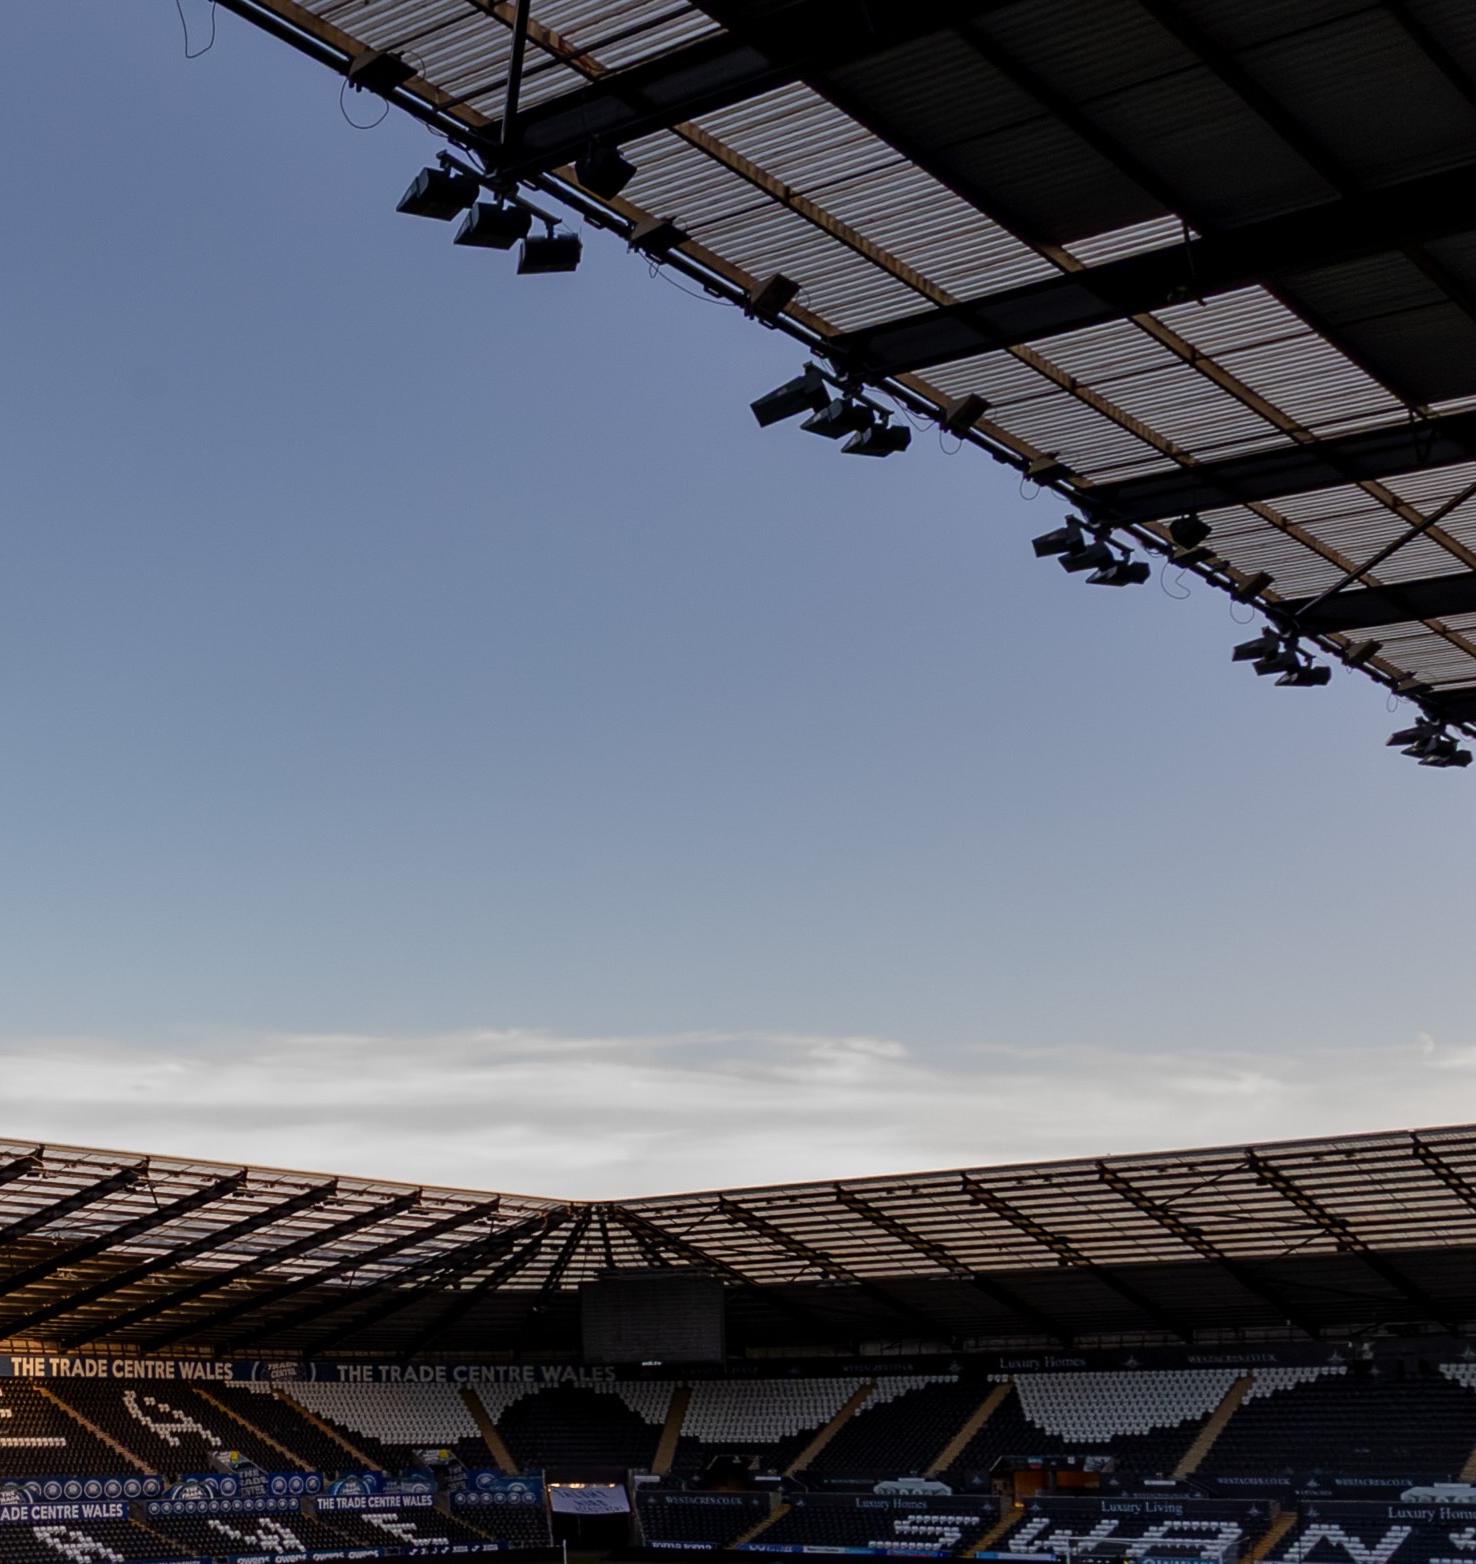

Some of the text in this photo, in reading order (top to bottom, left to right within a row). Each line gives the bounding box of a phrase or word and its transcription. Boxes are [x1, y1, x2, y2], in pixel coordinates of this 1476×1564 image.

[11, 1356, 234, 1381] THE TRADE CENTRE WALES
[1000, 1355, 1086, 1371] Luxury Homes
[336, 1365, 616, 1383] THE TRADE CENTRE WALES
[317, 1494, 433, 1510] THE TRADE CENTRE WALES
[855, 1497, 928, 1510] Luxury Homes
[1100, 1500, 1184, 1515] Luxury Living
[31, 1504, 79, 1520] CENTRE
[81, 1503, 123, 1518] WALES
[1388, 1506, 1436, 1521] Luxury
